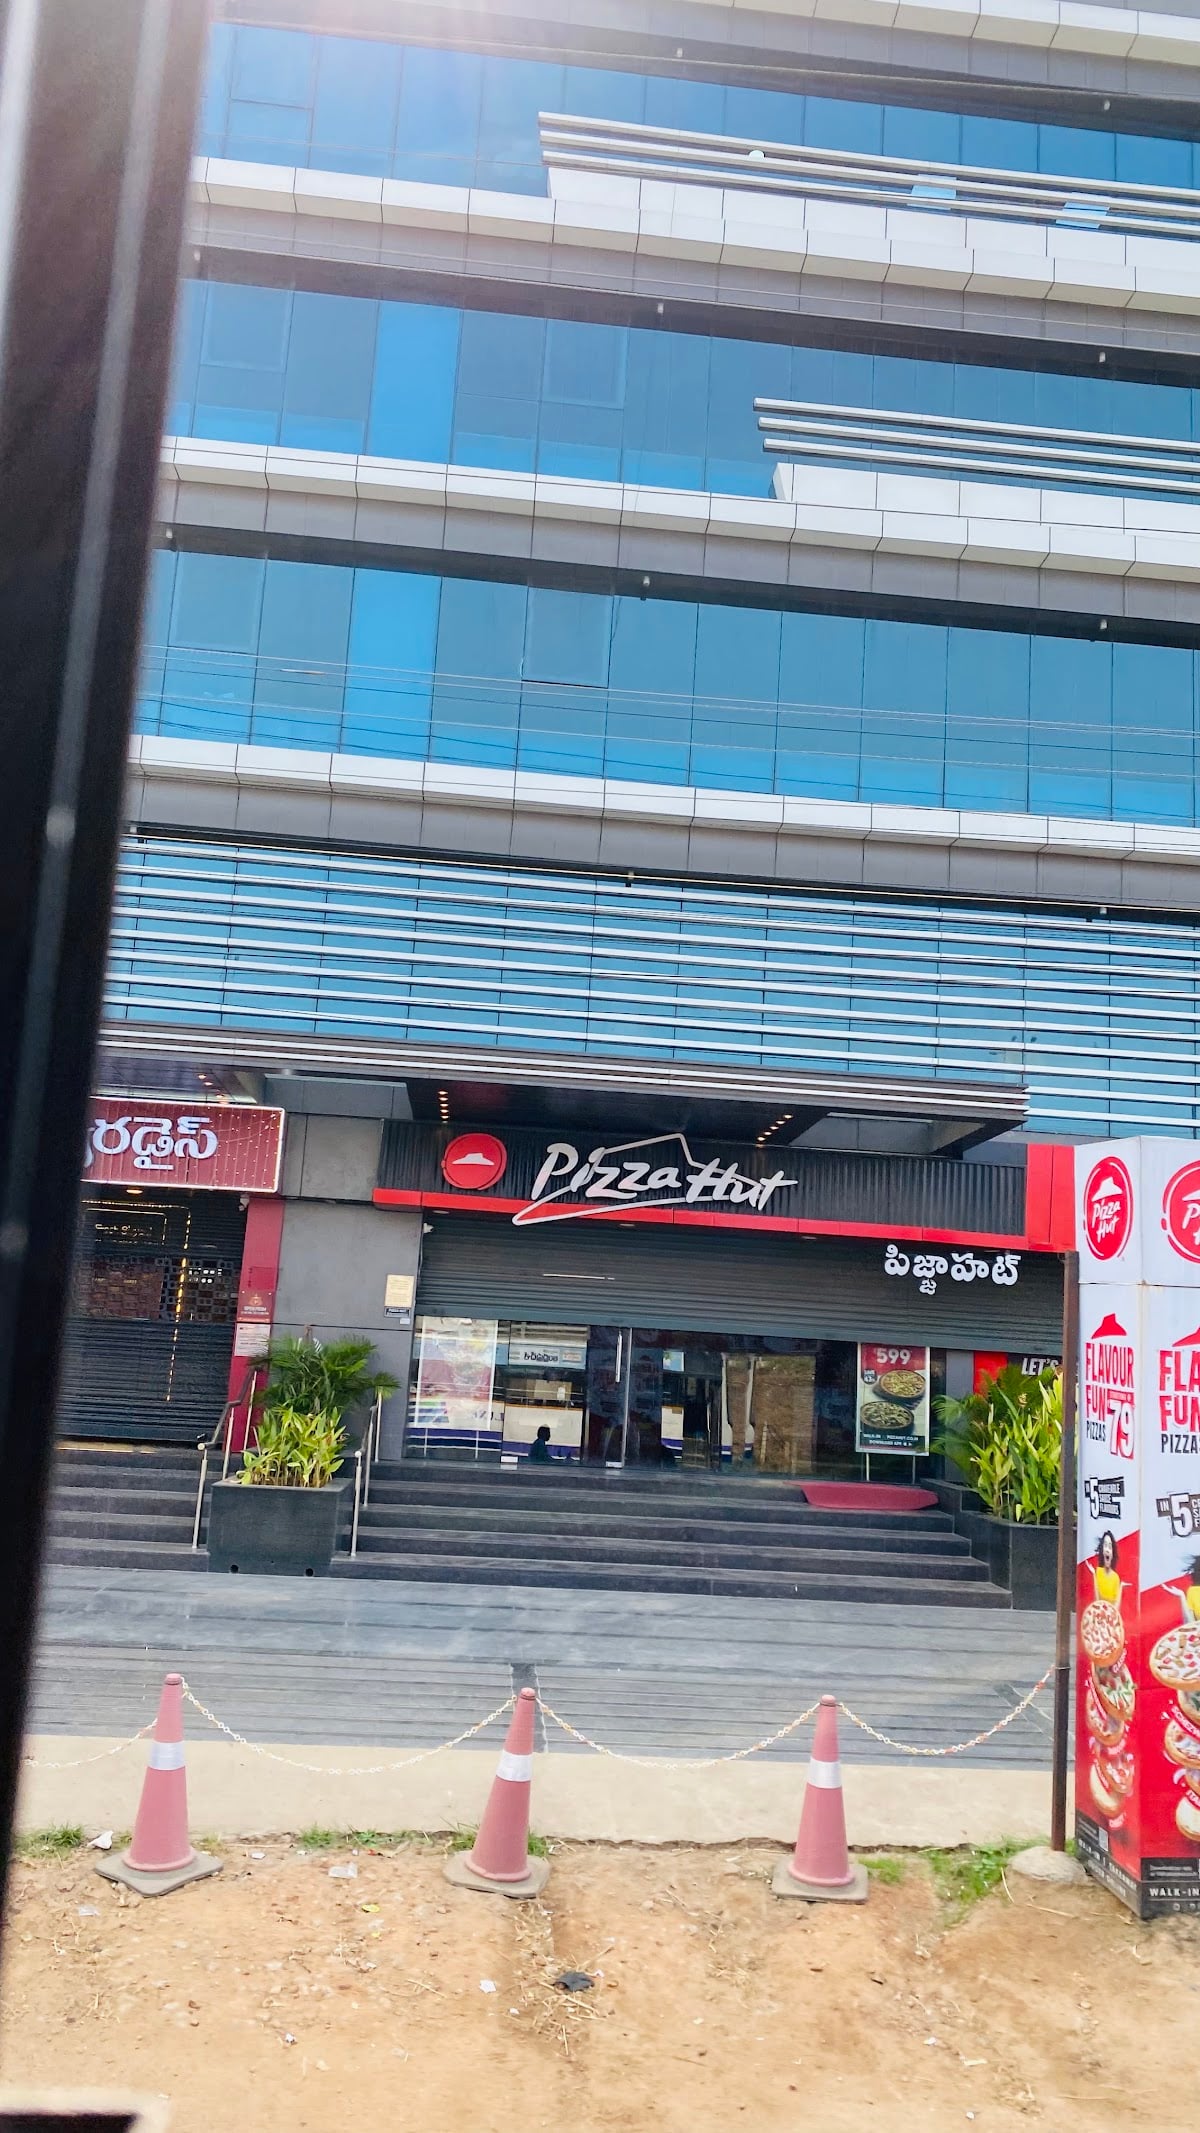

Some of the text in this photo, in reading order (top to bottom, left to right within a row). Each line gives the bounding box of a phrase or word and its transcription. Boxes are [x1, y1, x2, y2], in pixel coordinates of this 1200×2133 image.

[85, 1116, 219, 1171] రడైస్
[530, 1141, 799, 1211] Pizza Hut
[1091, 1198, 1121, 1229] Pizza
[1096, 1215, 1121, 1243] Hut
[1085, 1342, 1135, 1389] FLAVOUR
[1085, 1384, 1106, 1422] FUN
[1107, 1399, 1135, 1460] 79
[1086, 1420, 1107, 1443] PIZZAS
[1089, 1478, 1100, 1519] 5
[1159, 1499, 1170, 1512] IN
[1170, 1493, 1194, 1538] 5
